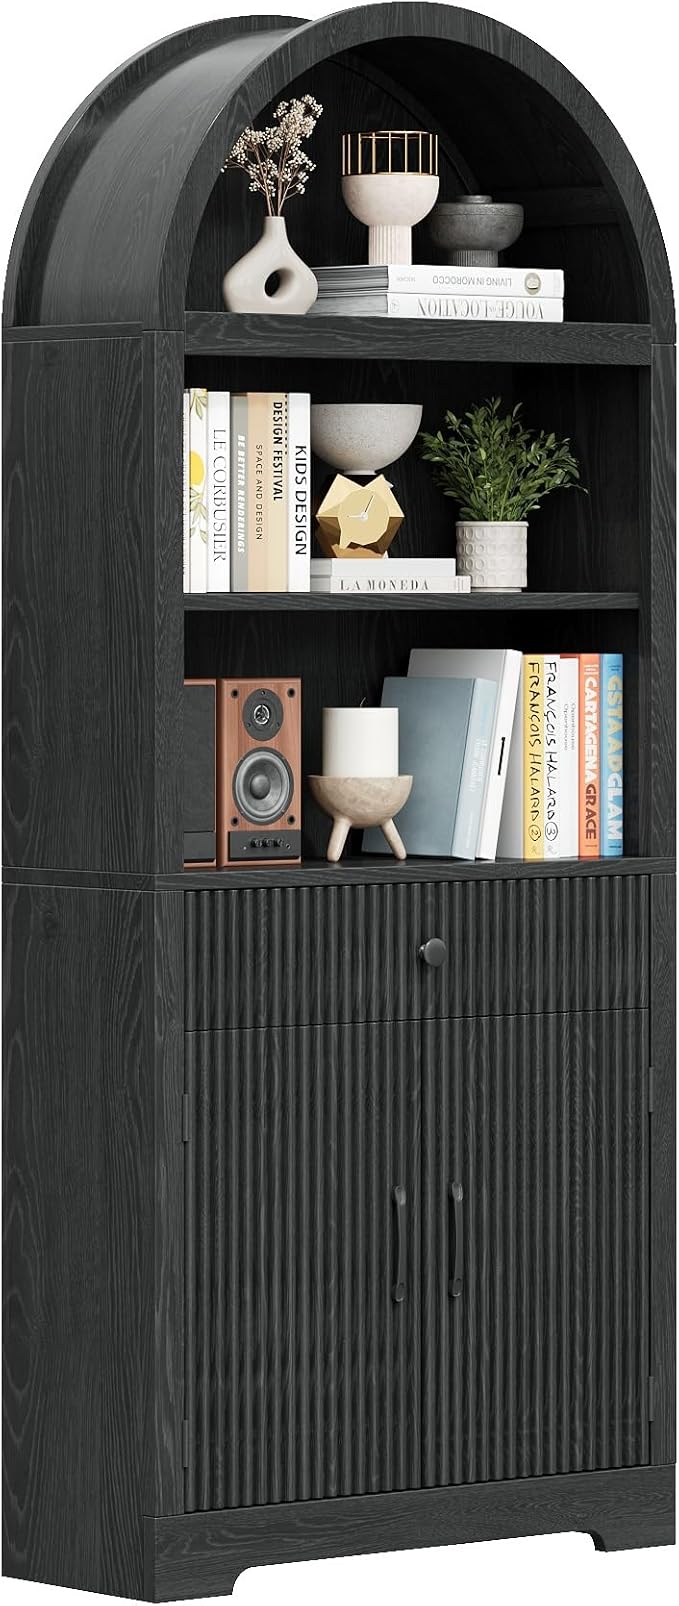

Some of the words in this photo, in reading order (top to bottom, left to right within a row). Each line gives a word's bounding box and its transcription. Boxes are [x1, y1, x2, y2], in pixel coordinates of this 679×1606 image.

[432, 275, 475, 286] MOROCCO
[475, 277, 485, 286] IN
[486, 278, 512, 288] LIVING
[417, 298, 488, 318] LOCATION
[213, 429, 226, 451] LE
[237, 434, 246, 448] BE
[273, 401, 283, 445] DESIGN
[237, 450, 246, 486] BETTER
[255, 444, 263, 475] SPACE
[273, 450, 283, 501] FESTIVAL
[295, 445, 307, 486] KIDS
[255, 479, 263, 500] AND
[213, 455, 226, 562] CORBUSIER
[237, 489, 246, 553] RENDERINGS
[255, 503, 263, 541] DESIGN
[295, 490, 307, 556] DESIGN
[340, 579, 361, 591] LA
[368, 579, 429, 591] MONEDA
[543, 661, 557, 746] FRANÇOIS
[528, 753, 542, 822] HALARD
[545, 751, 558, 820] HALARD
